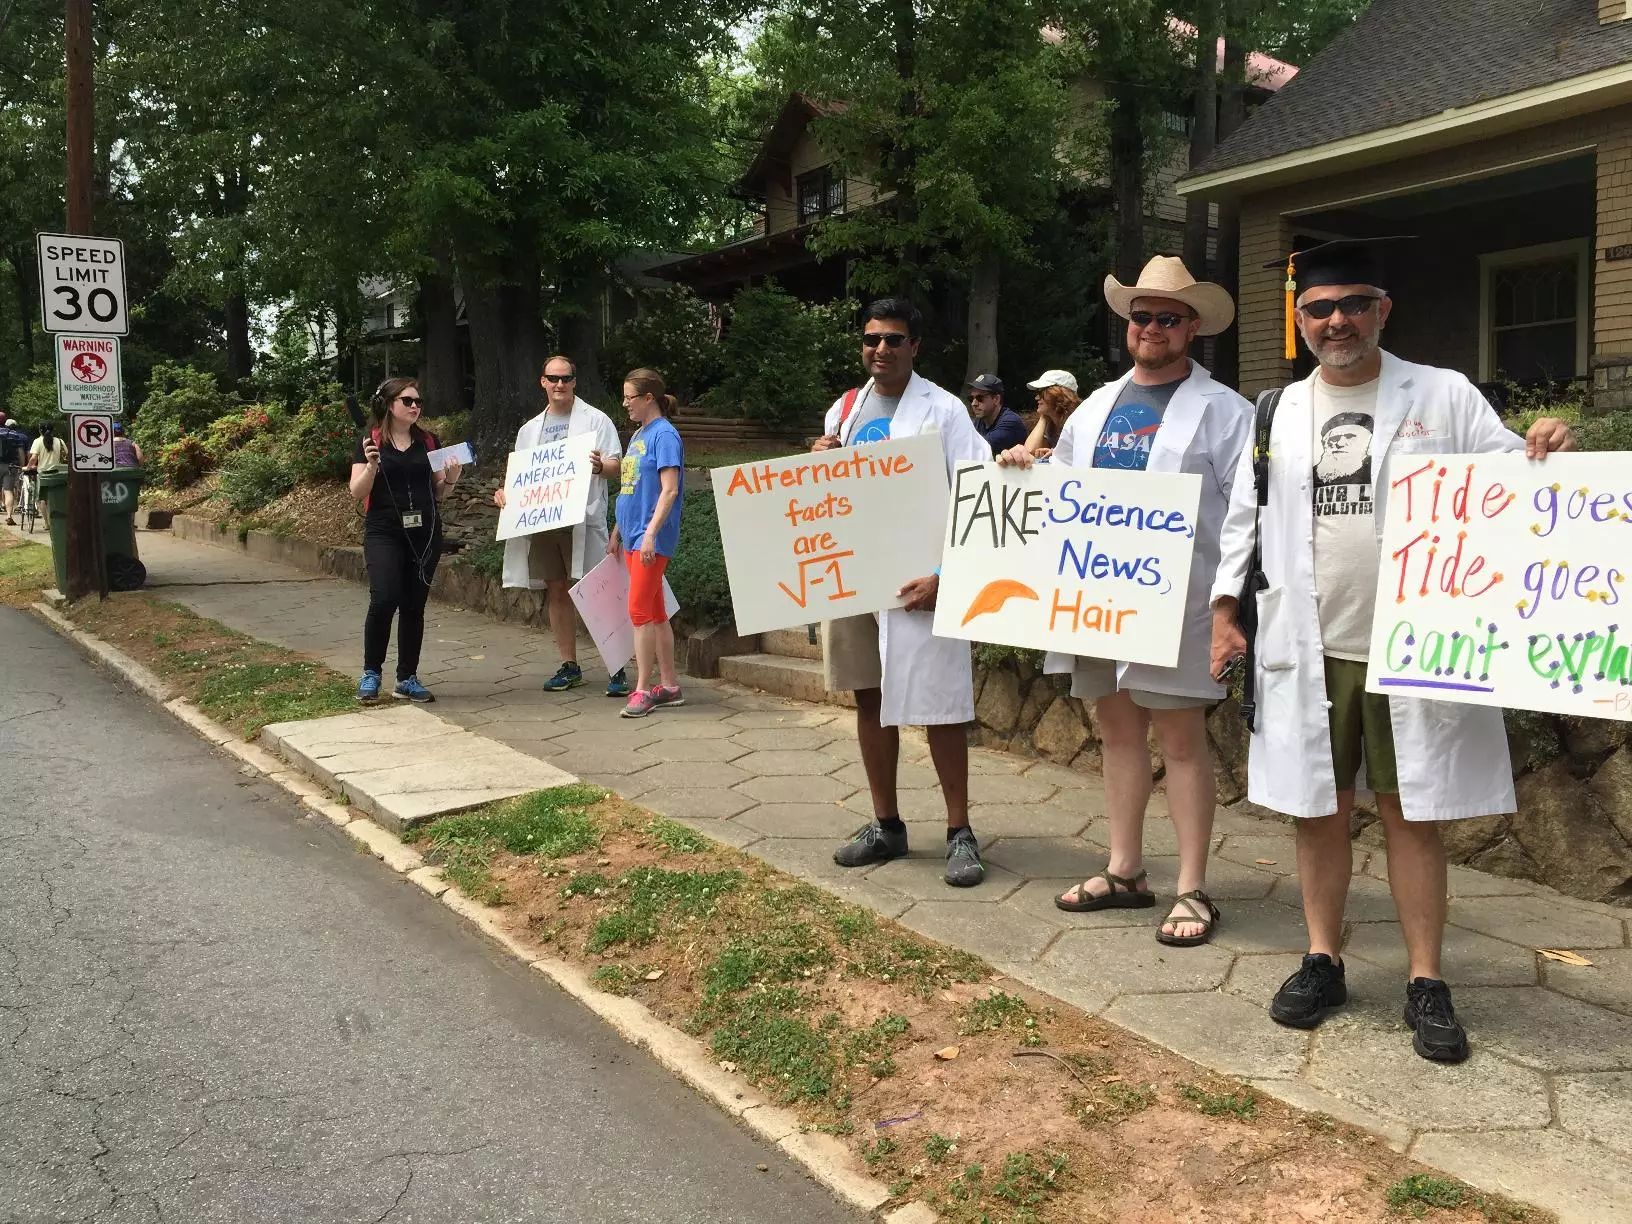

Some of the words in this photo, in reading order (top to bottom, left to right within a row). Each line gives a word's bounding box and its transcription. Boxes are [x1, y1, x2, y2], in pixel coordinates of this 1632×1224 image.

[47, 246, 116, 264] SPEED
[56, 267, 109, 283] LIMIT
[53, 286, 118, 322] 30
[63, 339, 113, 353] WARNING
[64, 384, 116, 394] NEIGHBORHOOD
[80, 393, 101, 401] WATCH
[531, 444, 566, 466] MAKE
[513, 461, 576, 488] AMERICA
[727, 451, 914, 496] Alternative
[519, 478, 574, 507] SMART
[1391, 458, 1516, 523] Tide
[515, 505, 563, 529] AGAIN
[784, 493, 853, 526] facts
[1049, 480, 1194, 538] Science,
[793, 532, 838, 555] are
[1058, 538, 1172, 595] News,
[1391, 529, 1504, 604] Tide
[1515, 559, 1625, 619] goes
[1049, 588, 1138, 634] Hair
[1527, 623, 1632, 694] expla
